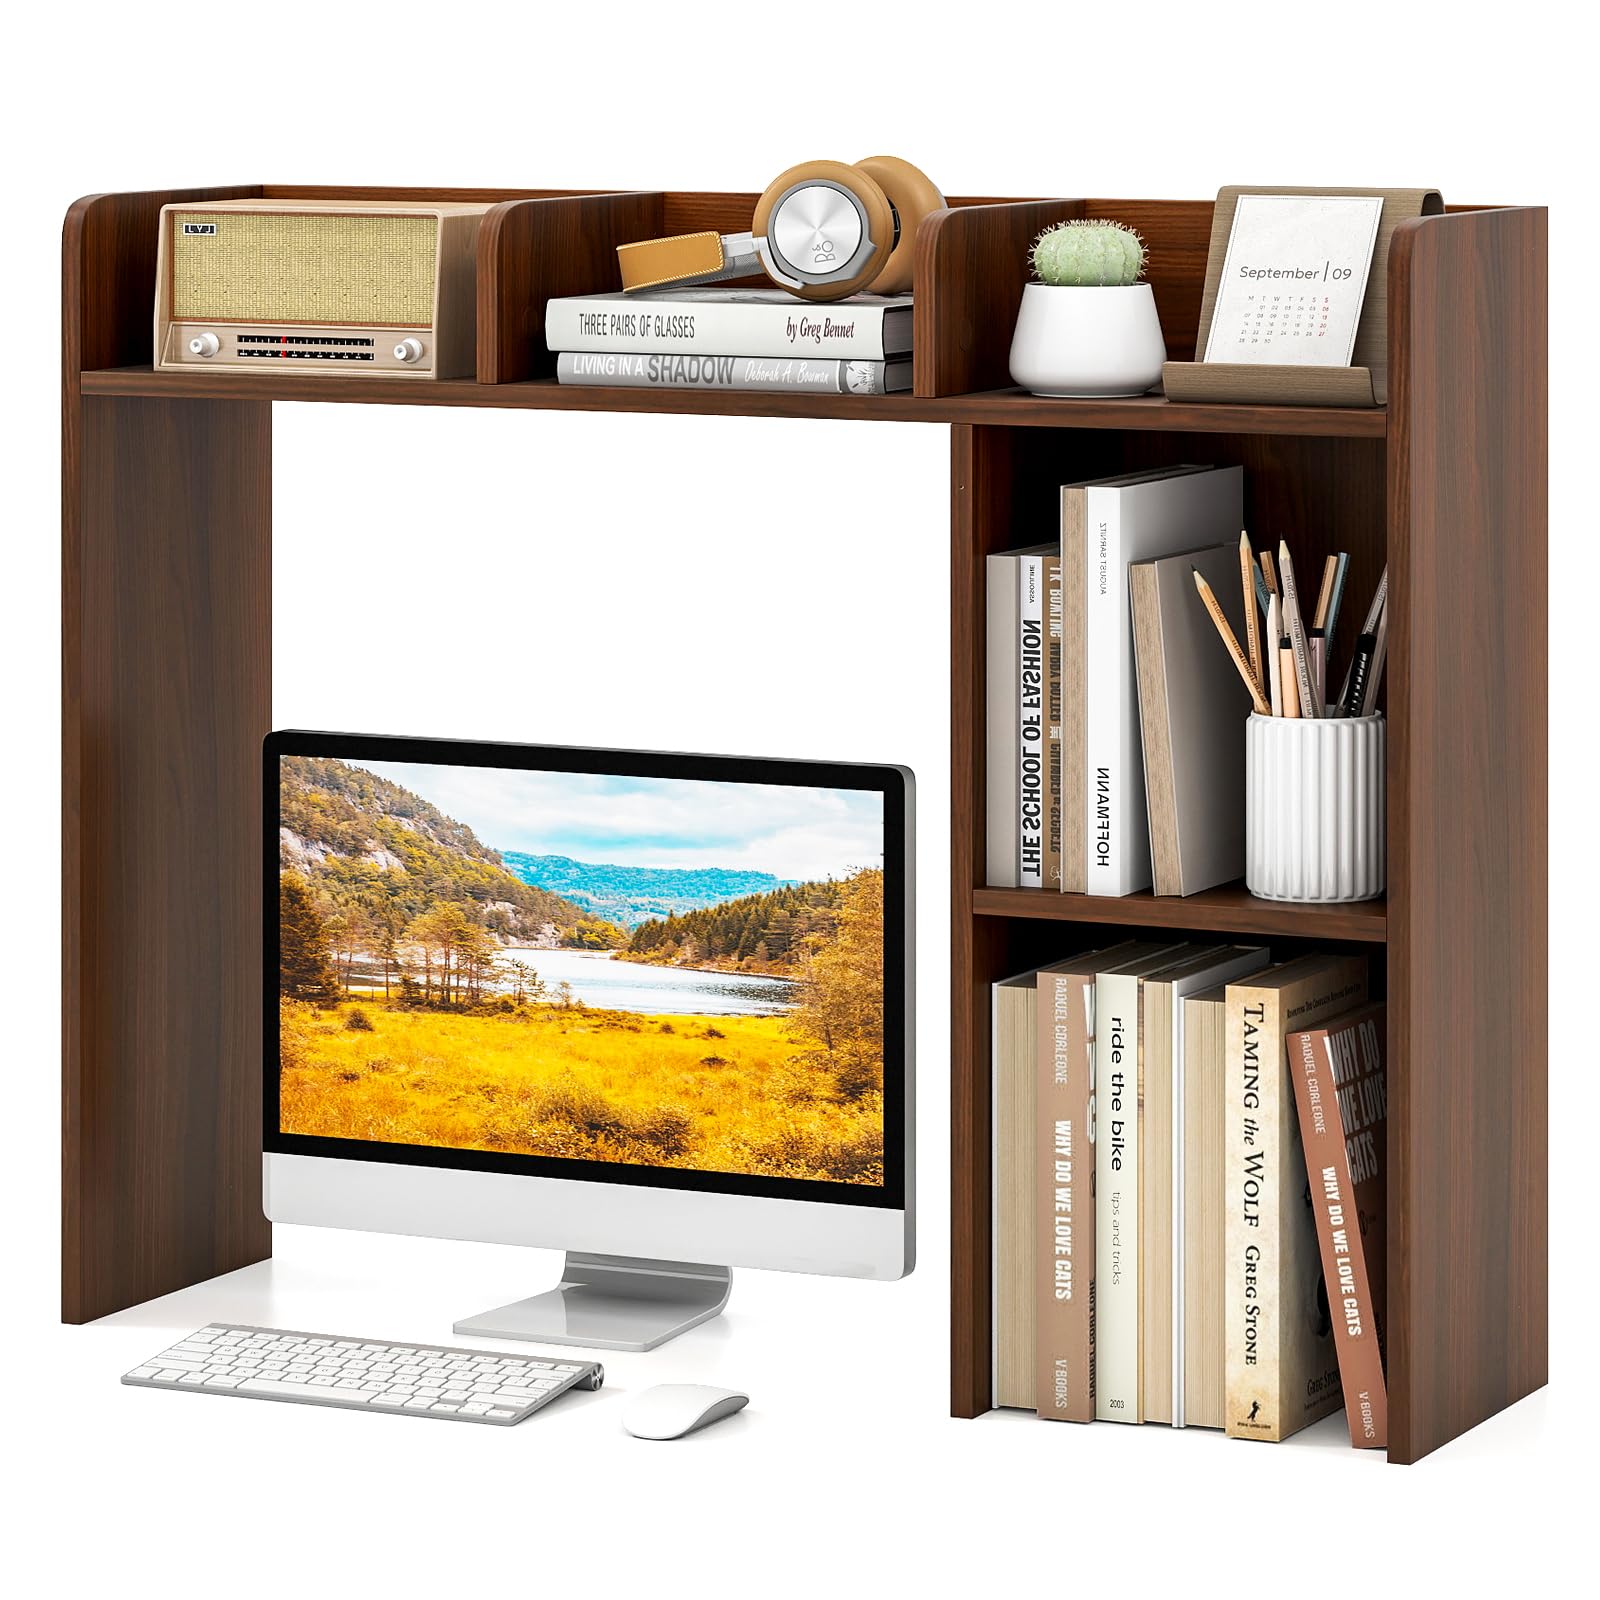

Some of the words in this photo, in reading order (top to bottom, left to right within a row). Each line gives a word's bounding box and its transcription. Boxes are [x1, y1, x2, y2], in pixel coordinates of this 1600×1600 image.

[1239, 266, 1320, 280] September
[1332, 268, 1352, 280] 09
[579, 314, 608, 336] THREE
[610, 314, 636, 336] PAIRS
[640, 315, 651, 337] OF
[654, 315, 695, 338] GLASSES
[786, 316, 798, 343] by
[800, 317, 822, 344] Greg
[824, 317, 855, 338] Bennet
[574, 355, 616, 375] LIVING
[618, 356, 632, 376] IN
[634, 357, 644, 376] A
[647, 355, 737, 384] SHADOW
[744, 360, 780, 383] Deborah
[1055, 978, 1068, 1022] RAQUEL
[1055, 1024, 1068, 1084] CORLEONE
[1112, 1018, 1124, 1064] ride
[1244, 1003, 1264, 1110] TAMING
[1358, 1020, 1380, 1073] DO
[1112, 1072, 1124, 1112] the
[1300, 1034, 1316, 1076] RAQUEL
[1308, 1078, 1326, 1135] CORLEONE
[1055, 1120, 1072, 1157] WHY
[1112, 1120, 1124, 1171] bike
[1244, 1118, 1260, 1146] the
[1055, 1160, 1072, 1183] DO
[1344, 1130, 1378, 1186] CATS
[1055, 1188, 1072, 1213] WE
[1244, 1152, 1264, 1228] WOLF
[1322, 1166, 1340, 1201] WHY
[1112, 1192, 1121, 1216] tips
[1328, 1204, 1345, 1226] DO
[1055, 1216, 1072, 1256] LOVE
[1112, 1220, 1122, 1247] and
[1332, 1229, 1349, 1254] WE
[1055, 1260, 1072, 1300] CATS
[1112, 1250, 1122, 1286] tricks
[1246, 1245, 1260, 1299] GREG
[1336, 1256, 1356, 1295] LOVE
[1246, 1304, 1260, 1366] STONE
[1344, 1297, 1362, 1337] CATS
[1110, 1399, 1125, 1409] 2003
